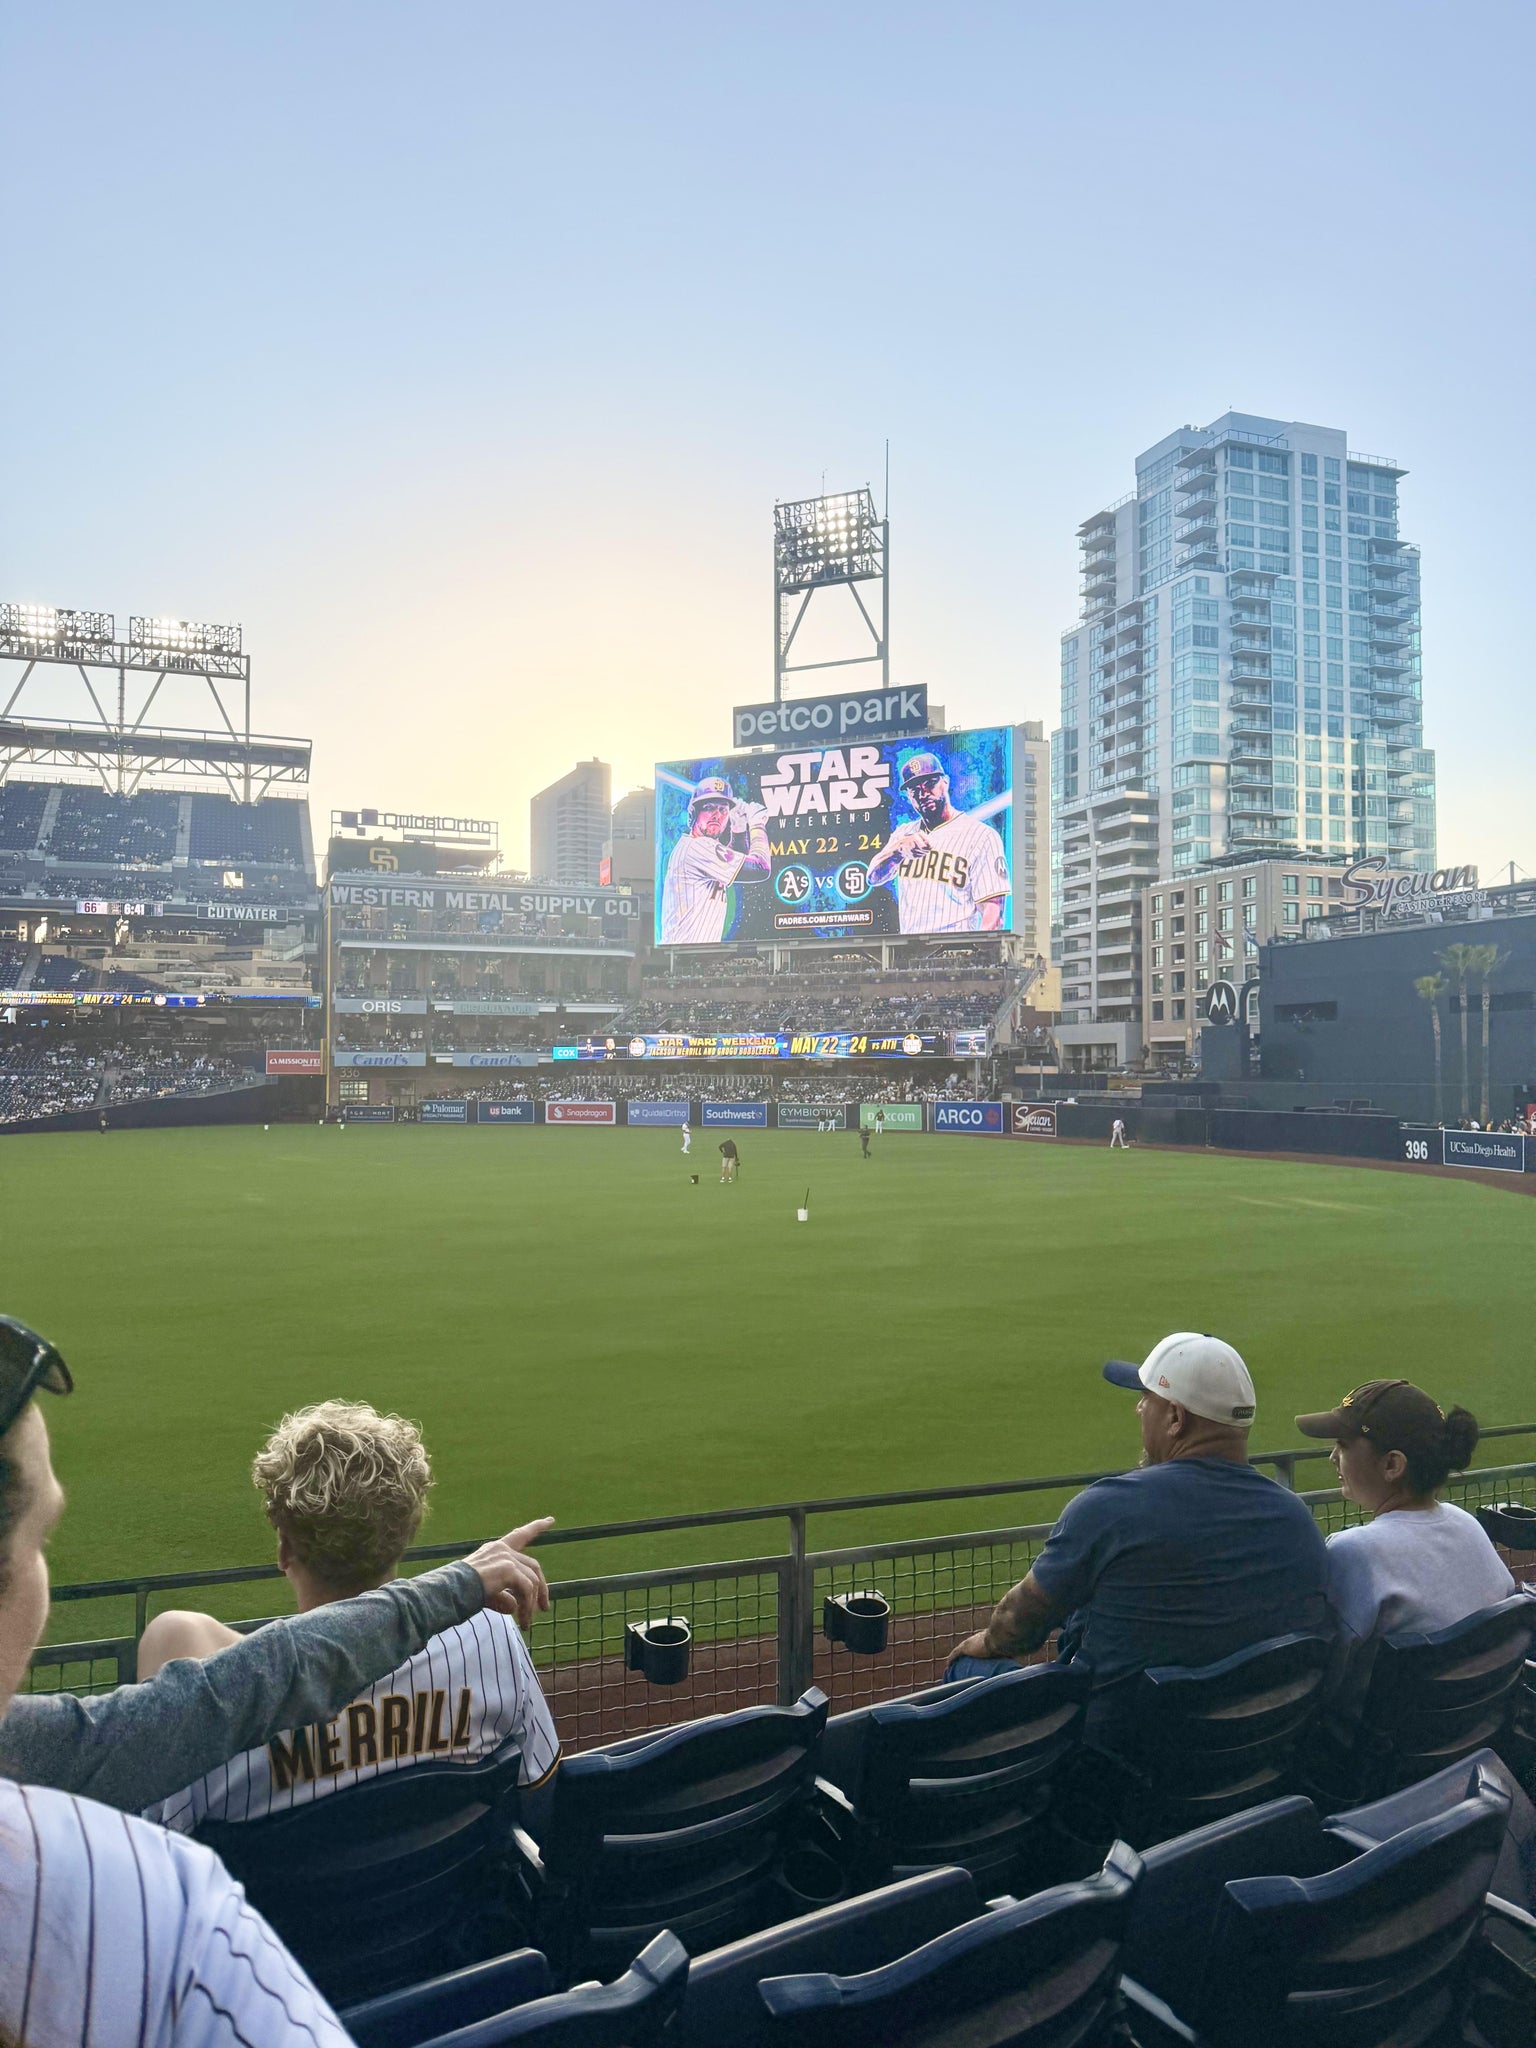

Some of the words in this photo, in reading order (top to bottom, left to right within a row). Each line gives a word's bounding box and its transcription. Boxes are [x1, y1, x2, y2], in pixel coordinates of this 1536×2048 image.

[735, 702, 833, 744] petco
[840, 690, 921, 733] park
[760, 746, 890, 787] STAR
[761, 776, 890, 817] WARS
[779, 811, 870, 829] WEEKEND
[769, 838, 811, 856] MAY
[815, 836, 839, 853] 22
[857, 833, 882, 851] 24
[1339, 855, 1479, 917] Sycuan
[331, 885, 435, 908] WESTERN
[445, 891, 515, 912] METAL
[520, 896, 597, 915] SUPPLY
[604, 899, 638, 917] CO.
[1396, 899, 1437, 913] CASINO
[123, 903, 145, 916] 6:41
[207, 906, 278, 921] CUTWATER
[778, 913, 870, 926] PADRES.COM/STARWARS
[82, 994, 101, 1005] MAY
[102, 994, 114, 1005] 22
[121, 994, 132, 1005] 24
[362, 1000, 402, 1014] ORIS
[657, 1038, 684, 1047] STAR
[688, 1037, 718, 1047] WARS
[722, 1037, 776, 1046] WEEKEND
[790, 1036, 818, 1055] MAY
[820, 1036, 838, 1054] 22
[849, 1036, 867, 1054] 24
[702, 1047, 716, 1056] AND
[352, 1053, 409, 1066] Canel's
[469, 1053, 522, 1066] Canel's
[339, 1067, 360, 1078] 336
[432, 1103, 465, 1114] Palomar
[489, 1107, 500, 1116] us
[501, 1104, 522, 1116] bank
[566, 1109, 608, 1120] Snapdragon
[641, 1109, 687, 1119] QuidelOrtho
[706, 1108, 756, 1120] Southwest
[867, 1111, 915, 1122] Dxcom
[937, 1109, 983, 1124] ARCO
[1015, 1106, 1052, 1132] Sycuan
[1405, 1141, 1428, 1160] 396
[1450, 1141, 1461, 1153] UC
[1461, 1142, 1474, 1154] San
[1474, 1143, 1493, 1157] Diego
[1493, 1144, 1516, 1157] Health
[268, 1688, 474, 1790] MERRILL
